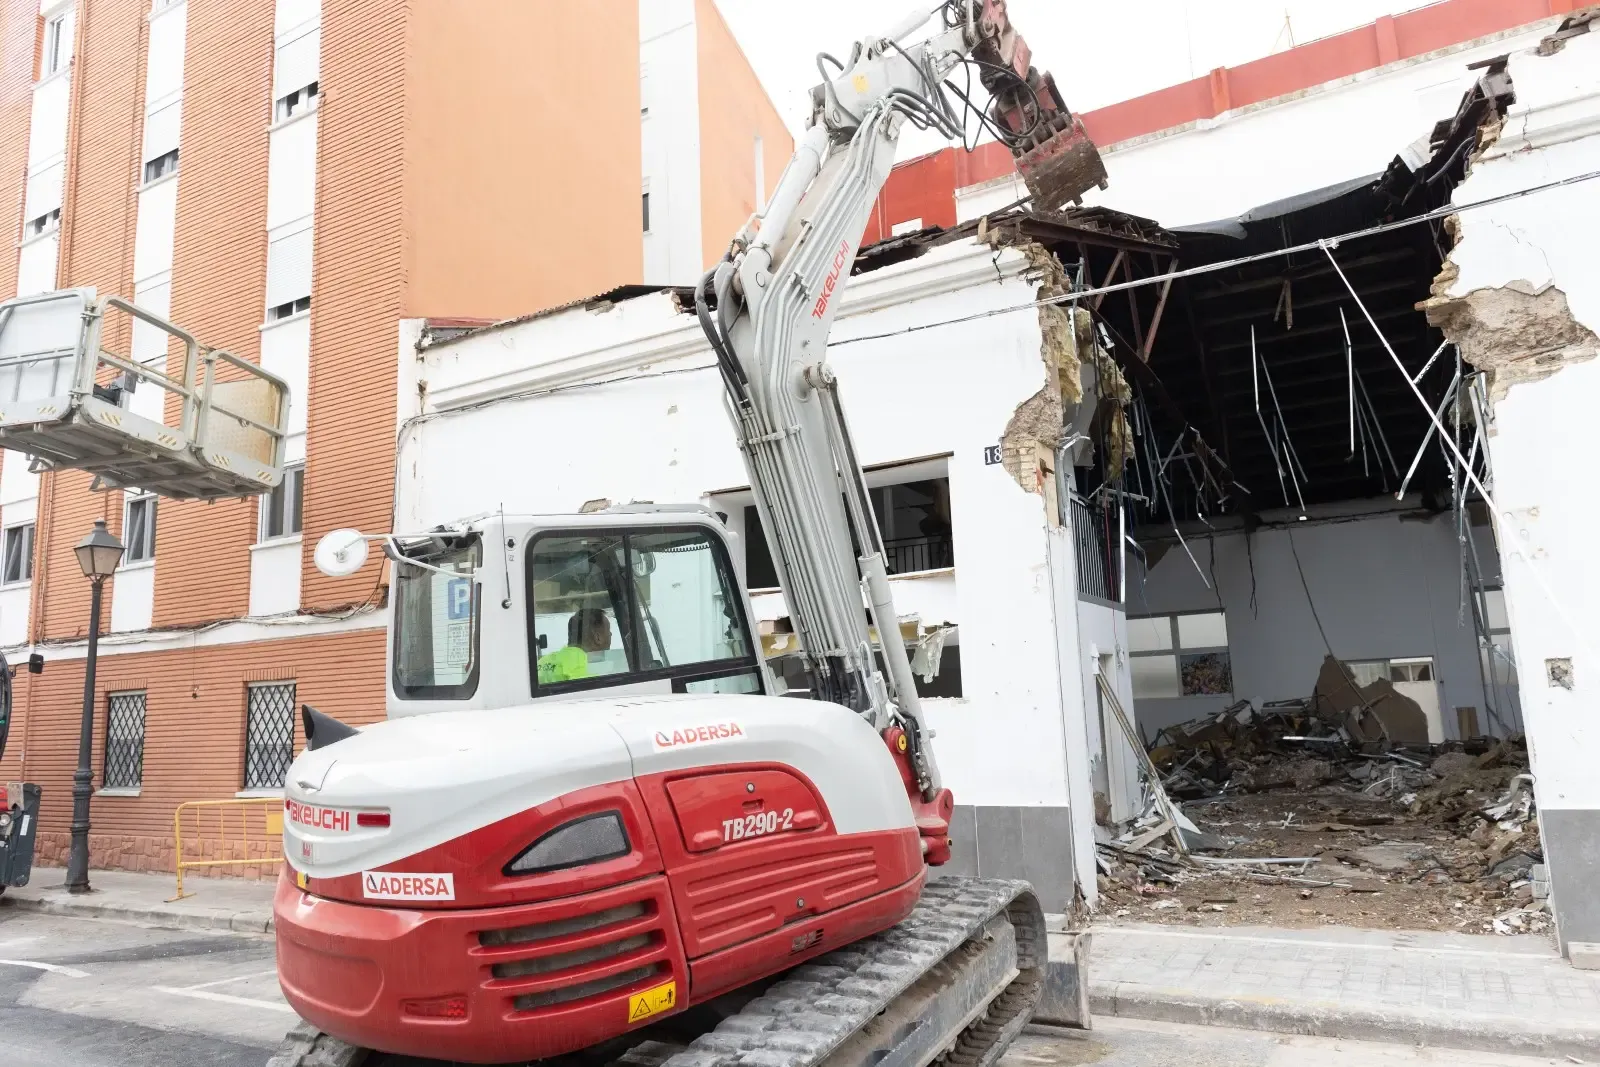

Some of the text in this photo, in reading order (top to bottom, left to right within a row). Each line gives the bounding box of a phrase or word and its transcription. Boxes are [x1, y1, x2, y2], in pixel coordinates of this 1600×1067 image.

[986, 447, 1002, 463] 18
[454, 583, 471, 614] P
[673, 722, 743, 745] ADERSA
[722, 807, 794, 842] TB290-2
[380, 877, 450, 896] ADERSA
